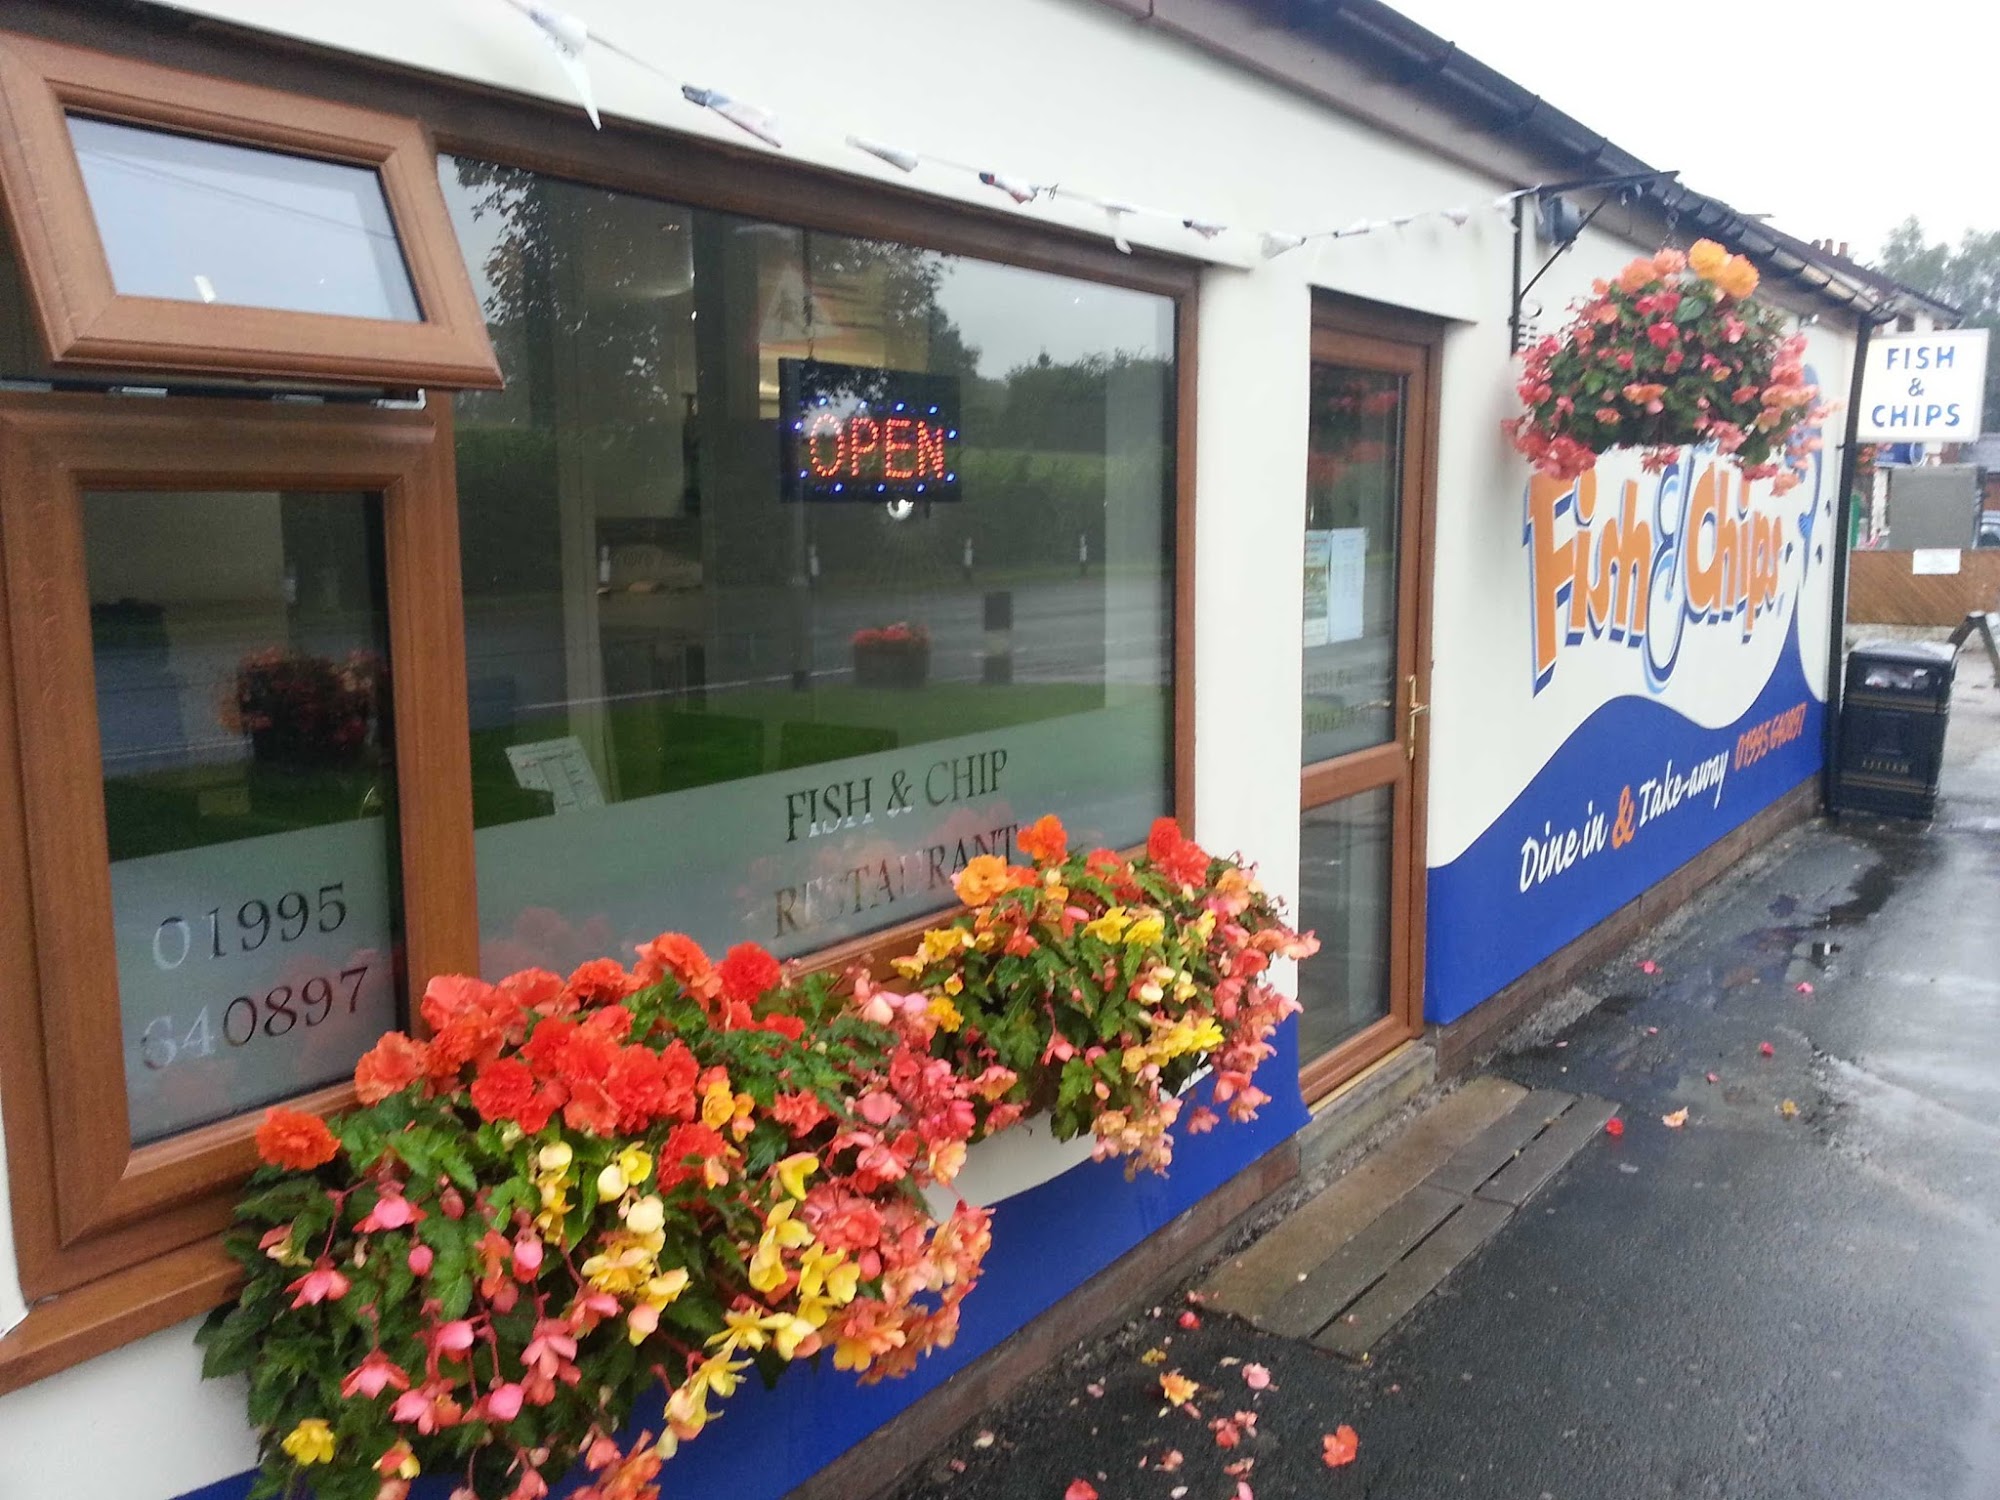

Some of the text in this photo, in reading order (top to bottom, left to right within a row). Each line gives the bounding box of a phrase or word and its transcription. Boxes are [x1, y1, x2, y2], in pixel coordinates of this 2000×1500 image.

[1887, 346, 1955, 370] FISH
[1908, 377, 1925, 397] &
[809, 412, 945, 479] OPEN
[1871, 403, 1960, 428] CHIPS
[1522, 464, 1652, 698] Fish
[1685, 459, 1786, 644] Chips
[786, 748, 1008, 842] FISH & CHIP
[1518, 820, 1582, 893] Dine
[1582, 800, 1609, 859] in
[1612, 784, 1636, 850] &
[1638, 749, 1729, 828] Take-away
[152, 882, 347, 970] 01995
[140, 966, 369, 1071] 640897
